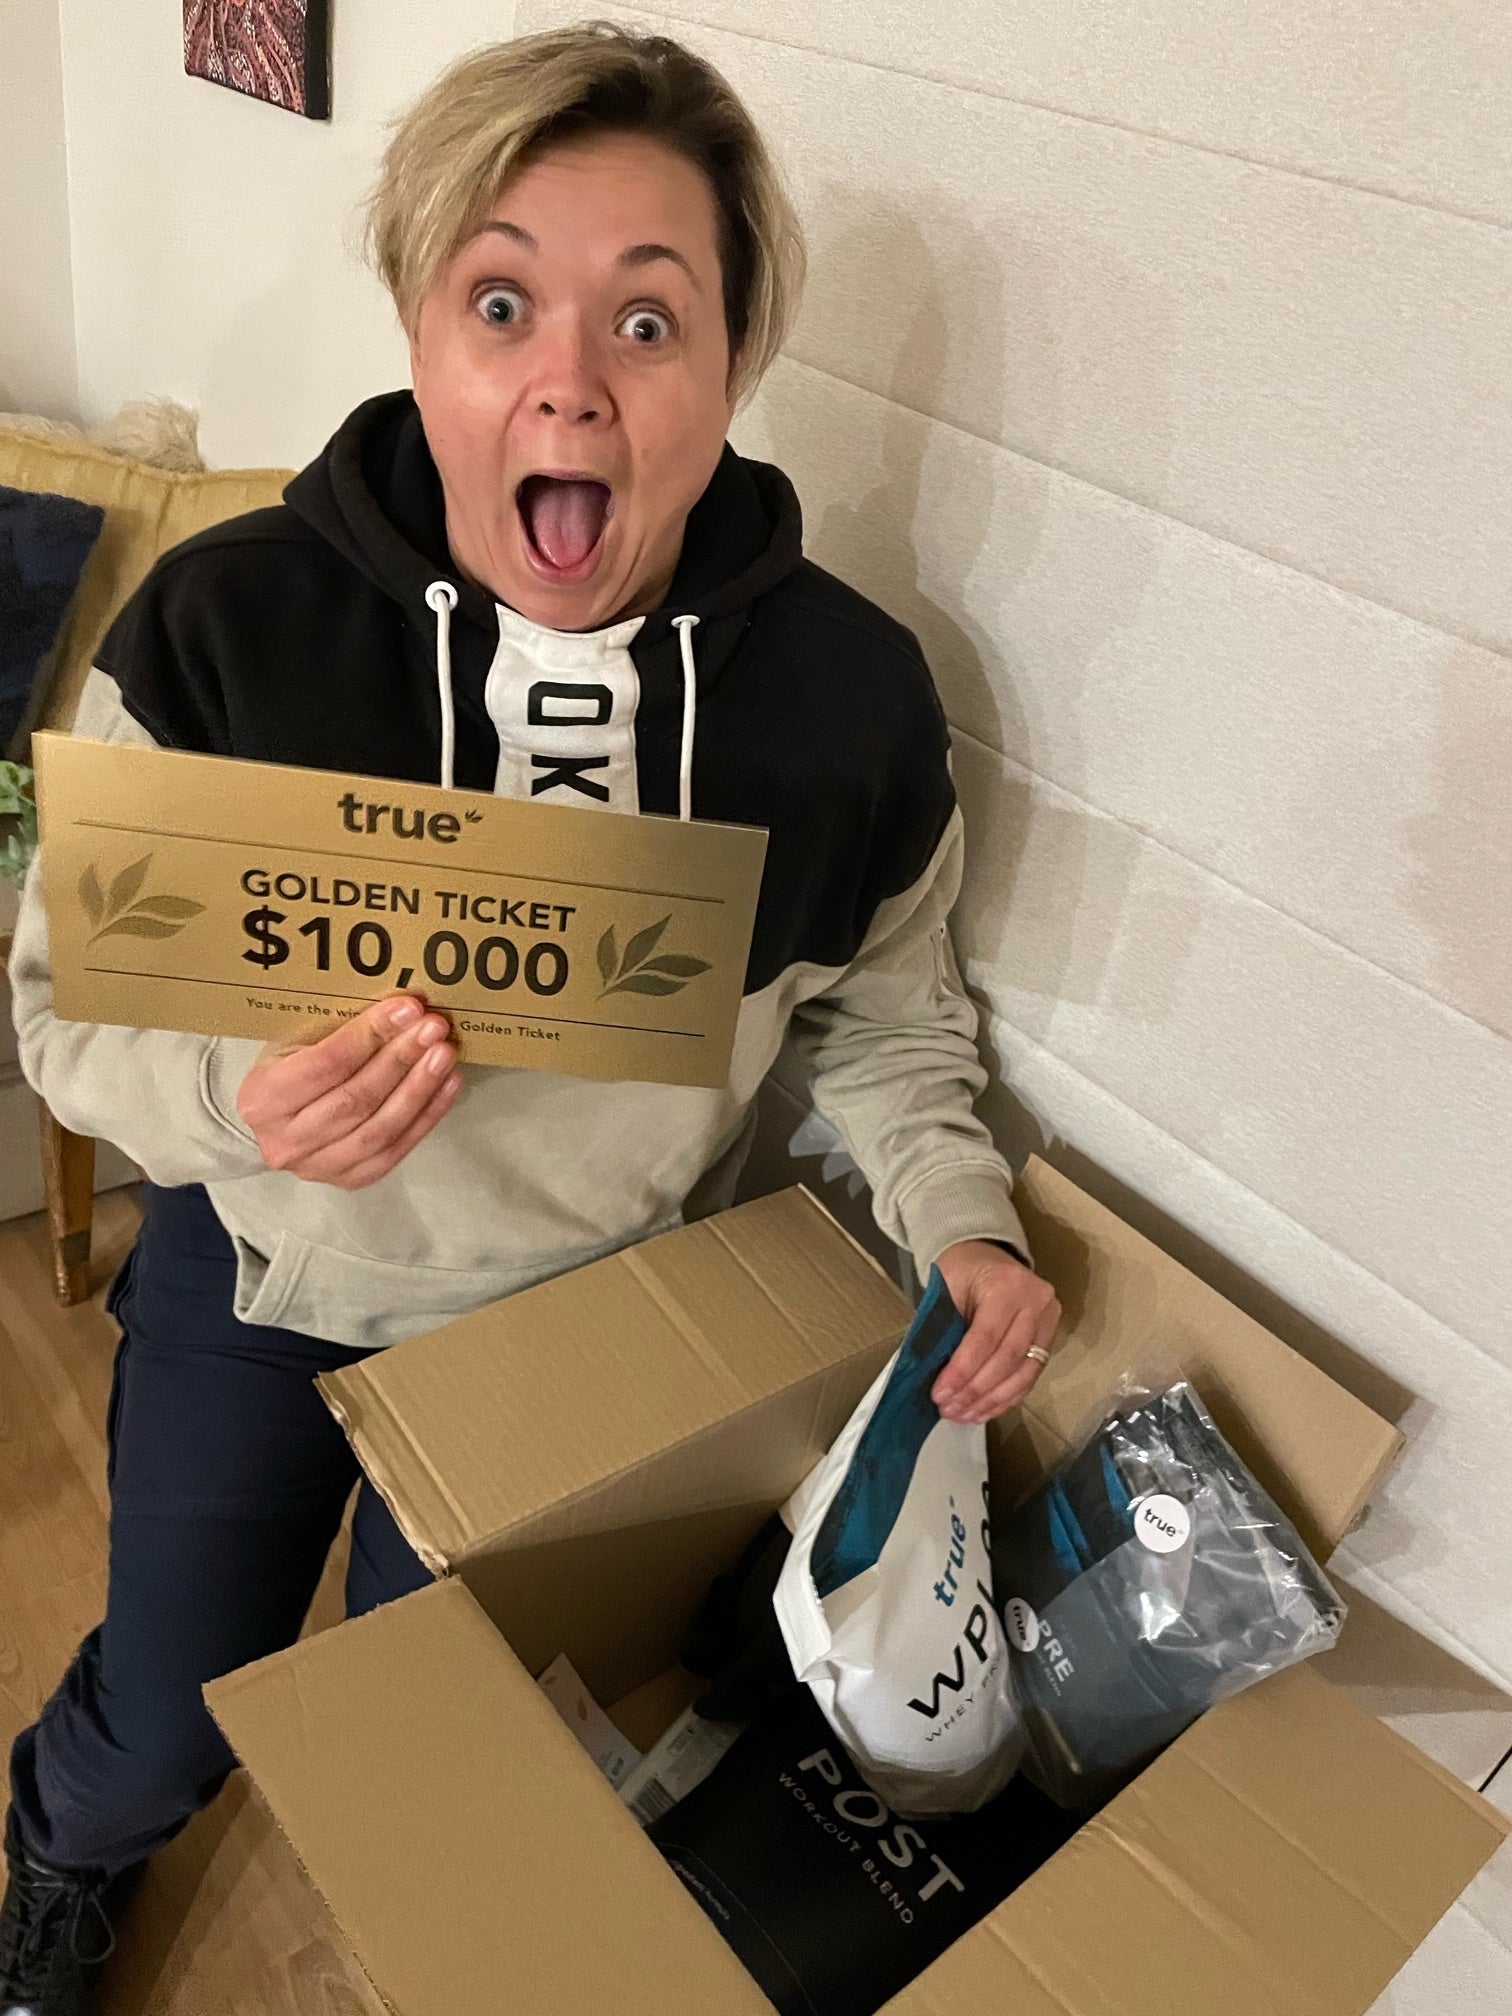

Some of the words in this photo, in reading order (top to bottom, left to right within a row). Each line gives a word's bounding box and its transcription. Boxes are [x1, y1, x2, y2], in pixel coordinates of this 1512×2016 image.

[337, 793, 462, 843] true
[240, 869, 420, 914] GOLDEN
[435, 891, 577, 932] TICKET
[241, 904, 569, 996] $10,000
[246, 998, 273, 1010] You
[278, 1003, 302, 1013] are
[307, 1004, 331, 1017] the
[460, 1020, 512, 1036] Golden
[517, 1026, 561, 1041] Ticket
[1143, 1508, 1176, 1537] true
[933, 1513, 966, 1607] true
[1039, 1618, 1076, 1683] PRE
[924, 1696, 976, 1743] WHEY
[778, 1772, 862, 1852] WORKOUT
[861, 1857, 915, 1925] BLEND
[797, 1748, 966, 1902] POST
